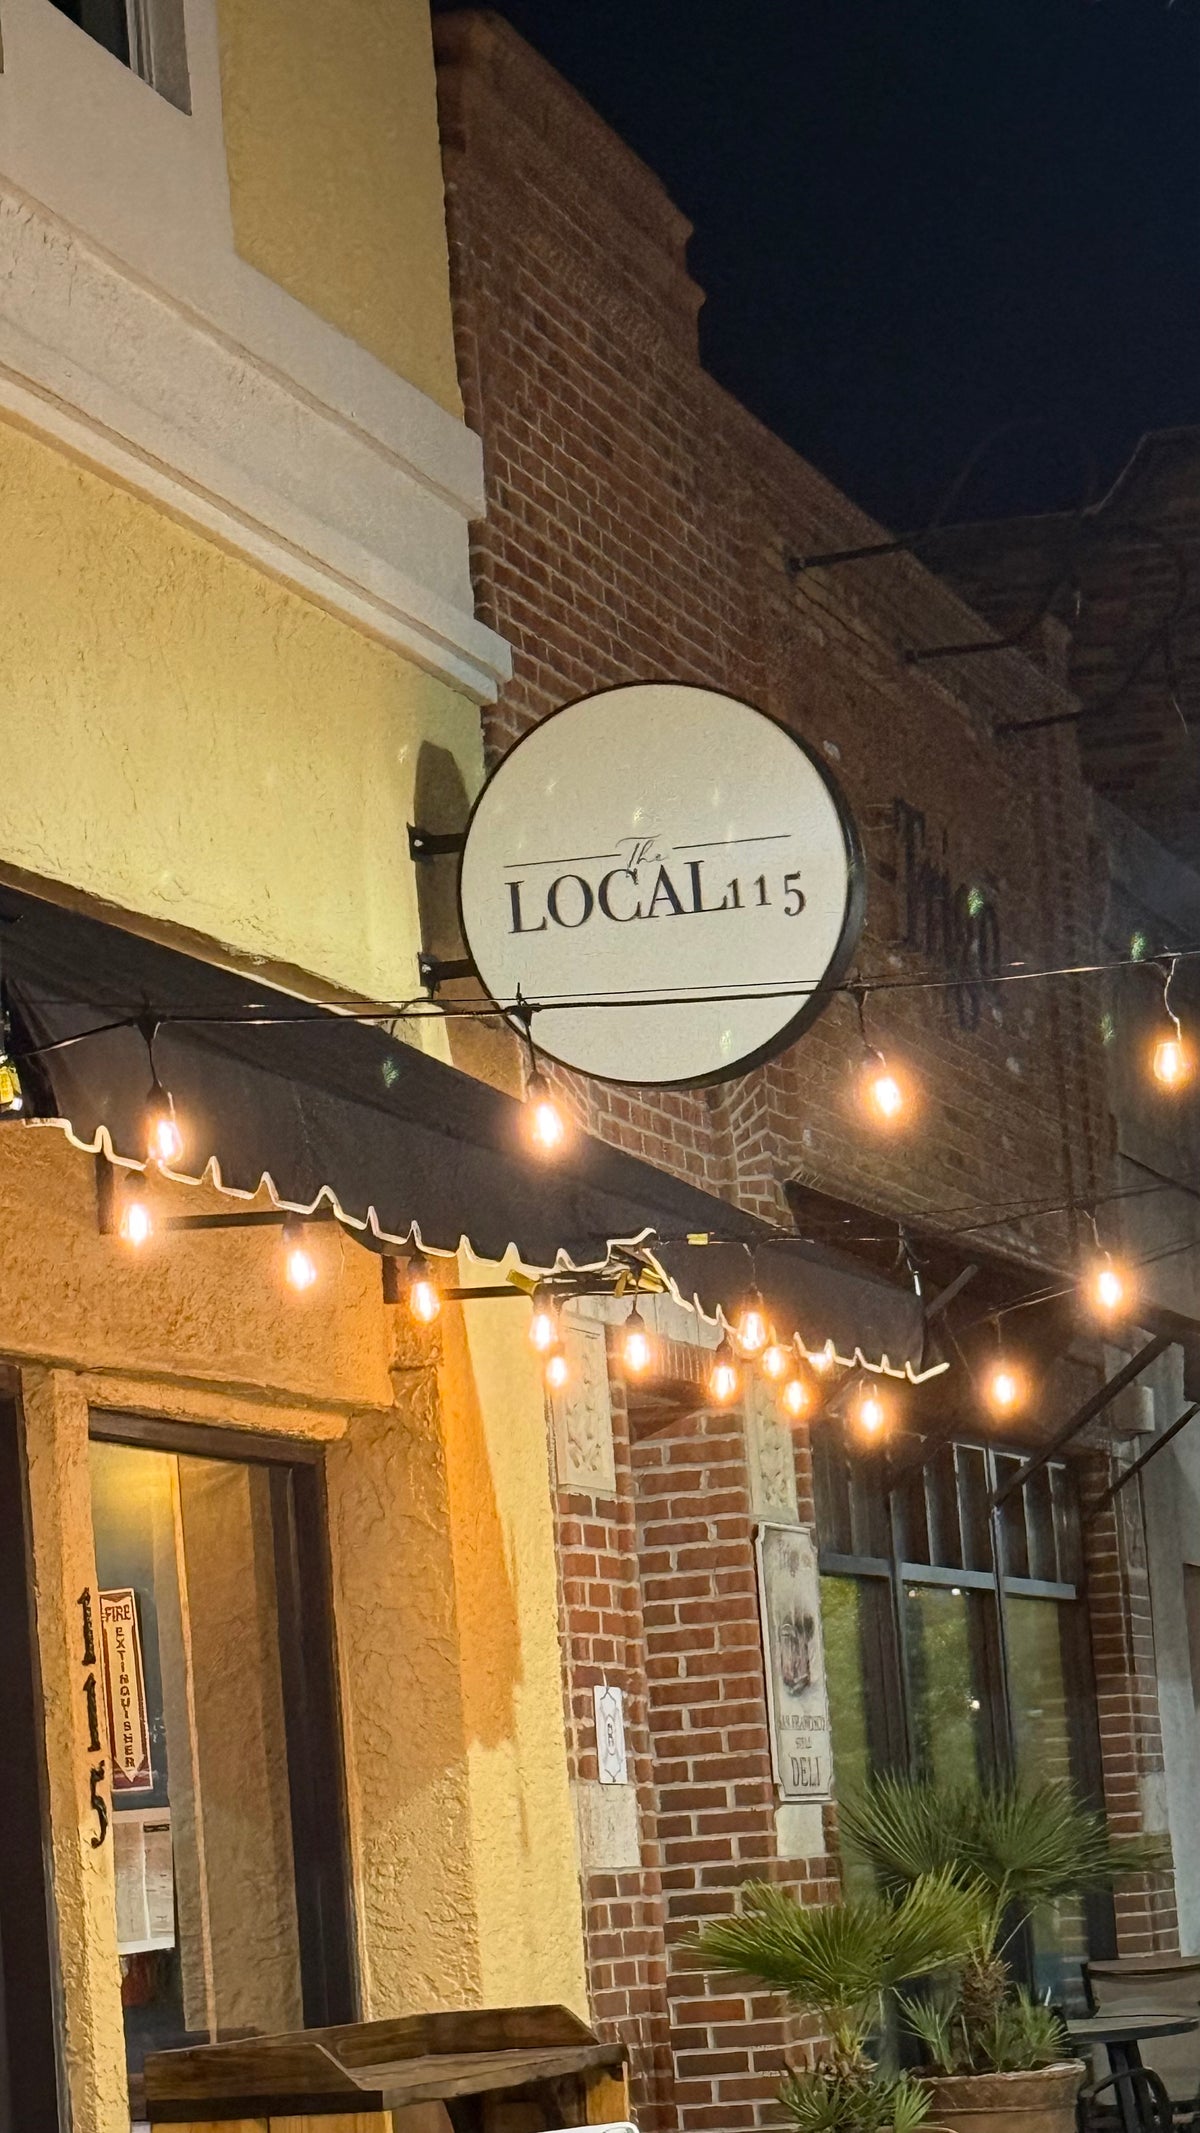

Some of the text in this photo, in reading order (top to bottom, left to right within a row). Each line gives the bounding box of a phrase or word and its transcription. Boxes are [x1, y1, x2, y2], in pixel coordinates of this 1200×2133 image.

[614, 833, 669, 869] The
[104, 1604, 132, 1622] FIRE
[115, 1626, 136, 1768] EXTINGUISHER
[76, 1587, 108, 1848] 115
[790, 1756, 820, 1787] DELI
